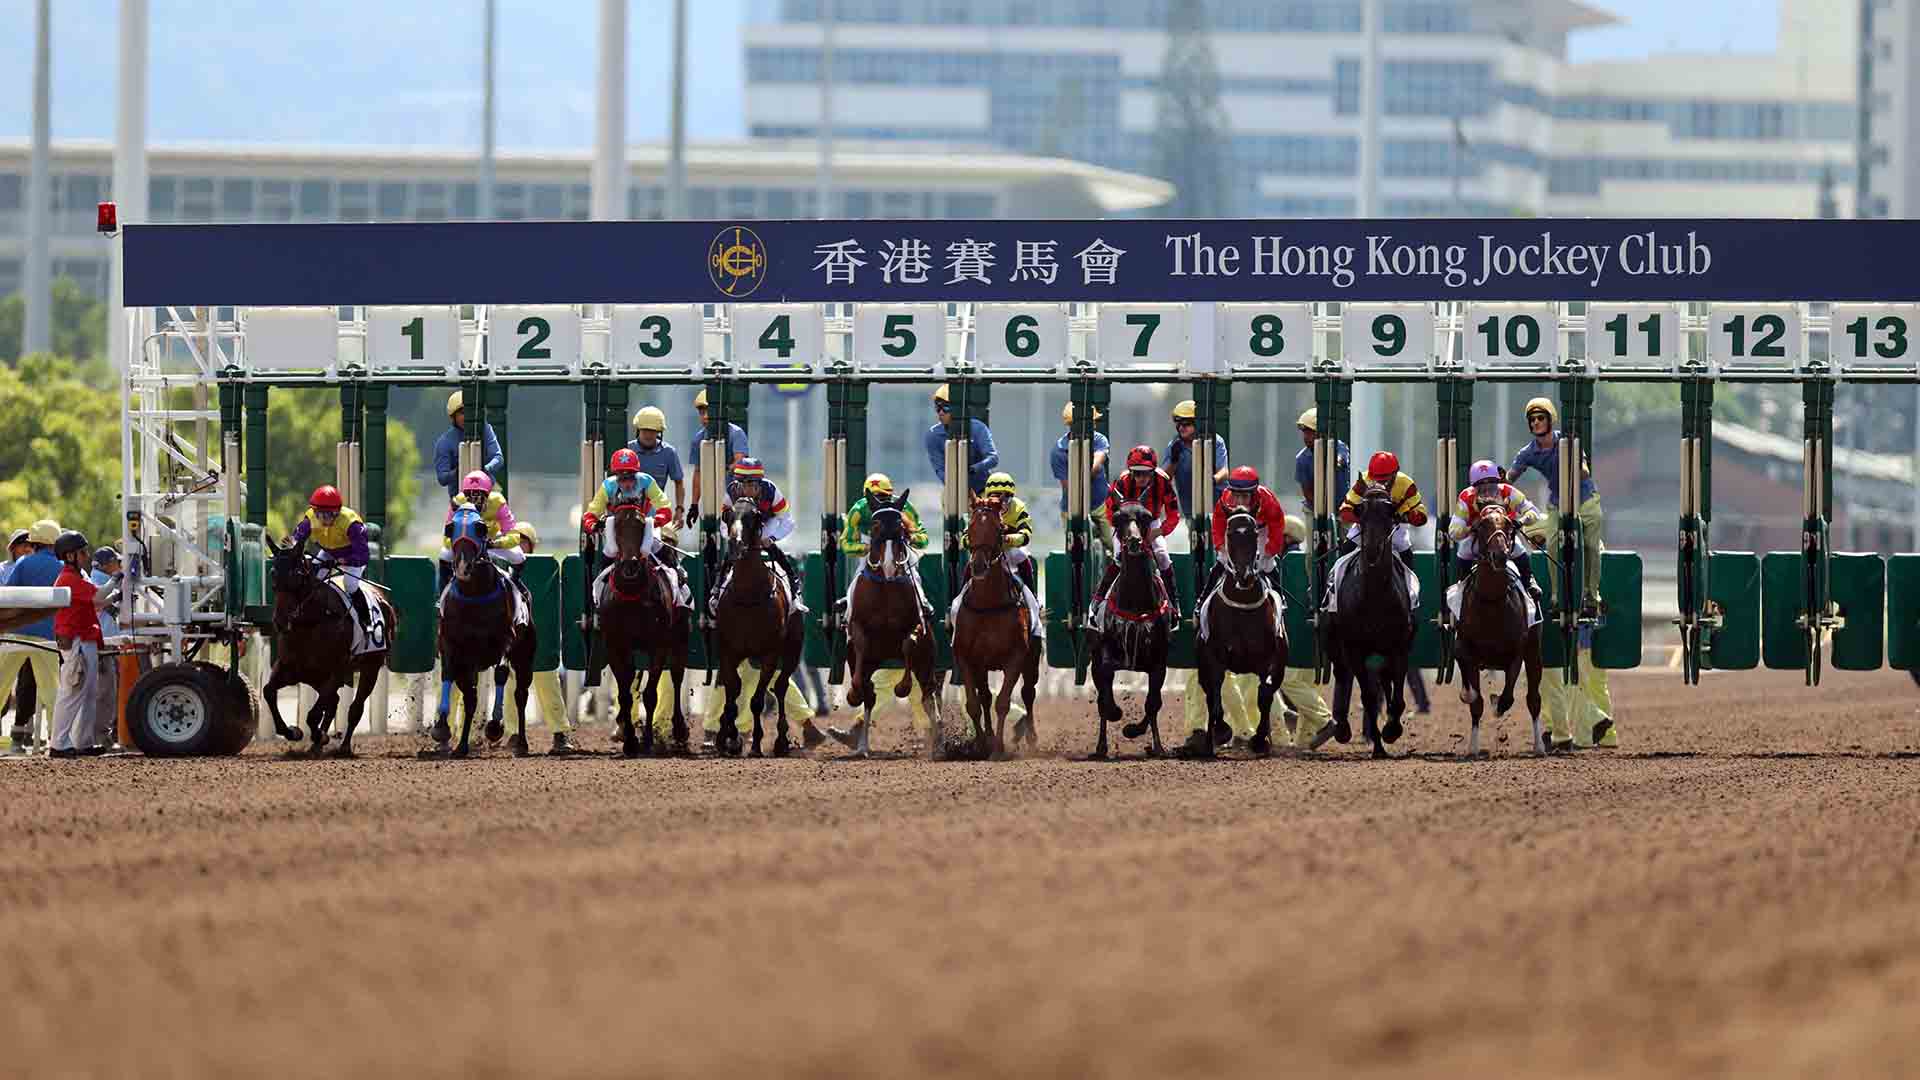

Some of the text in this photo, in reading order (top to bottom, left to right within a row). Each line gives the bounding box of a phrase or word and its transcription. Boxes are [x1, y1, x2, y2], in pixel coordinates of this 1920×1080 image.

[811, 238, 1128, 286] 香港賽馬會
[1165, 231, 1712, 288] The Hong Kong Jockey Club
[401, 317, 424, 361] 1
[516, 316, 551, 360] 2
[638, 315, 673, 358] 3
[758, 315, 796, 358] 4
[881, 314, 917, 358] 5
[1004, 314, 1040, 358] 6
[1125, 313, 1161, 357] 7
[1249, 314, 1285, 357] 8
[1371, 314, 1407, 357] 9
[1477, 314, 1541, 357] 10
[1605, 313, 1661, 357] 11
[1722, 314, 1786, 358] 12
[1845, 316, 1908, 359] 13
